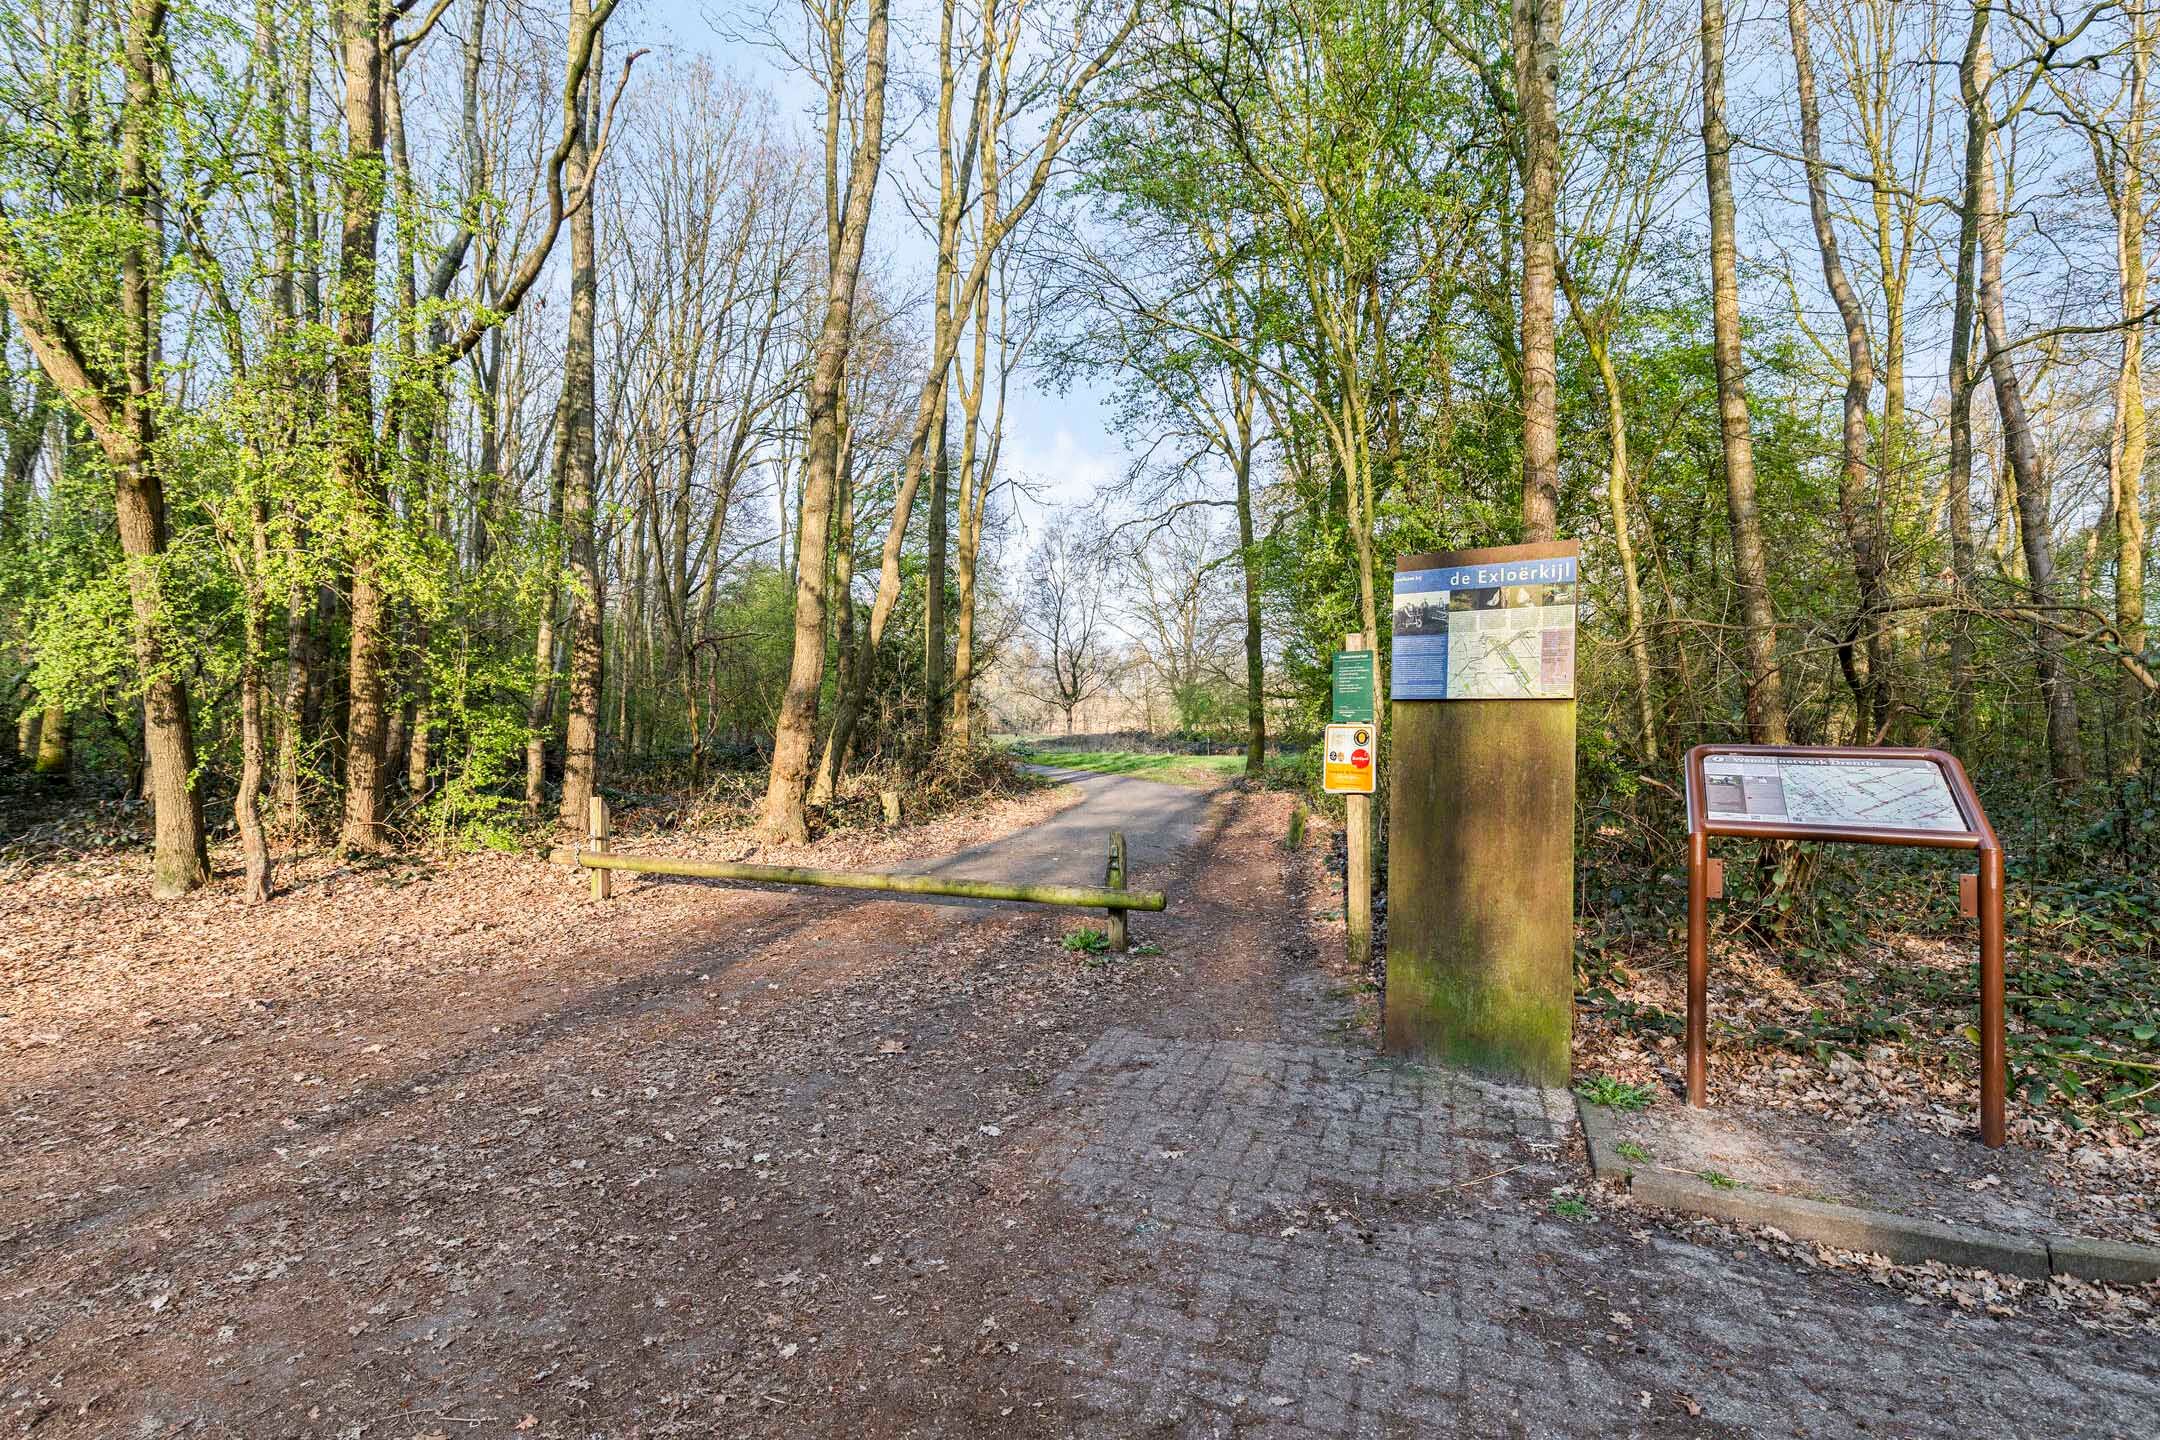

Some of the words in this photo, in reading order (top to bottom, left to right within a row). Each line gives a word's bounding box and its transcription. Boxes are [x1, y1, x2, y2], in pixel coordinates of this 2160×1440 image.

[1450, 571, 1471, 586] de
[1478, 562, 1570, 584] Exloërkijl
[1830, 760, 1881, 768] Drenthe
